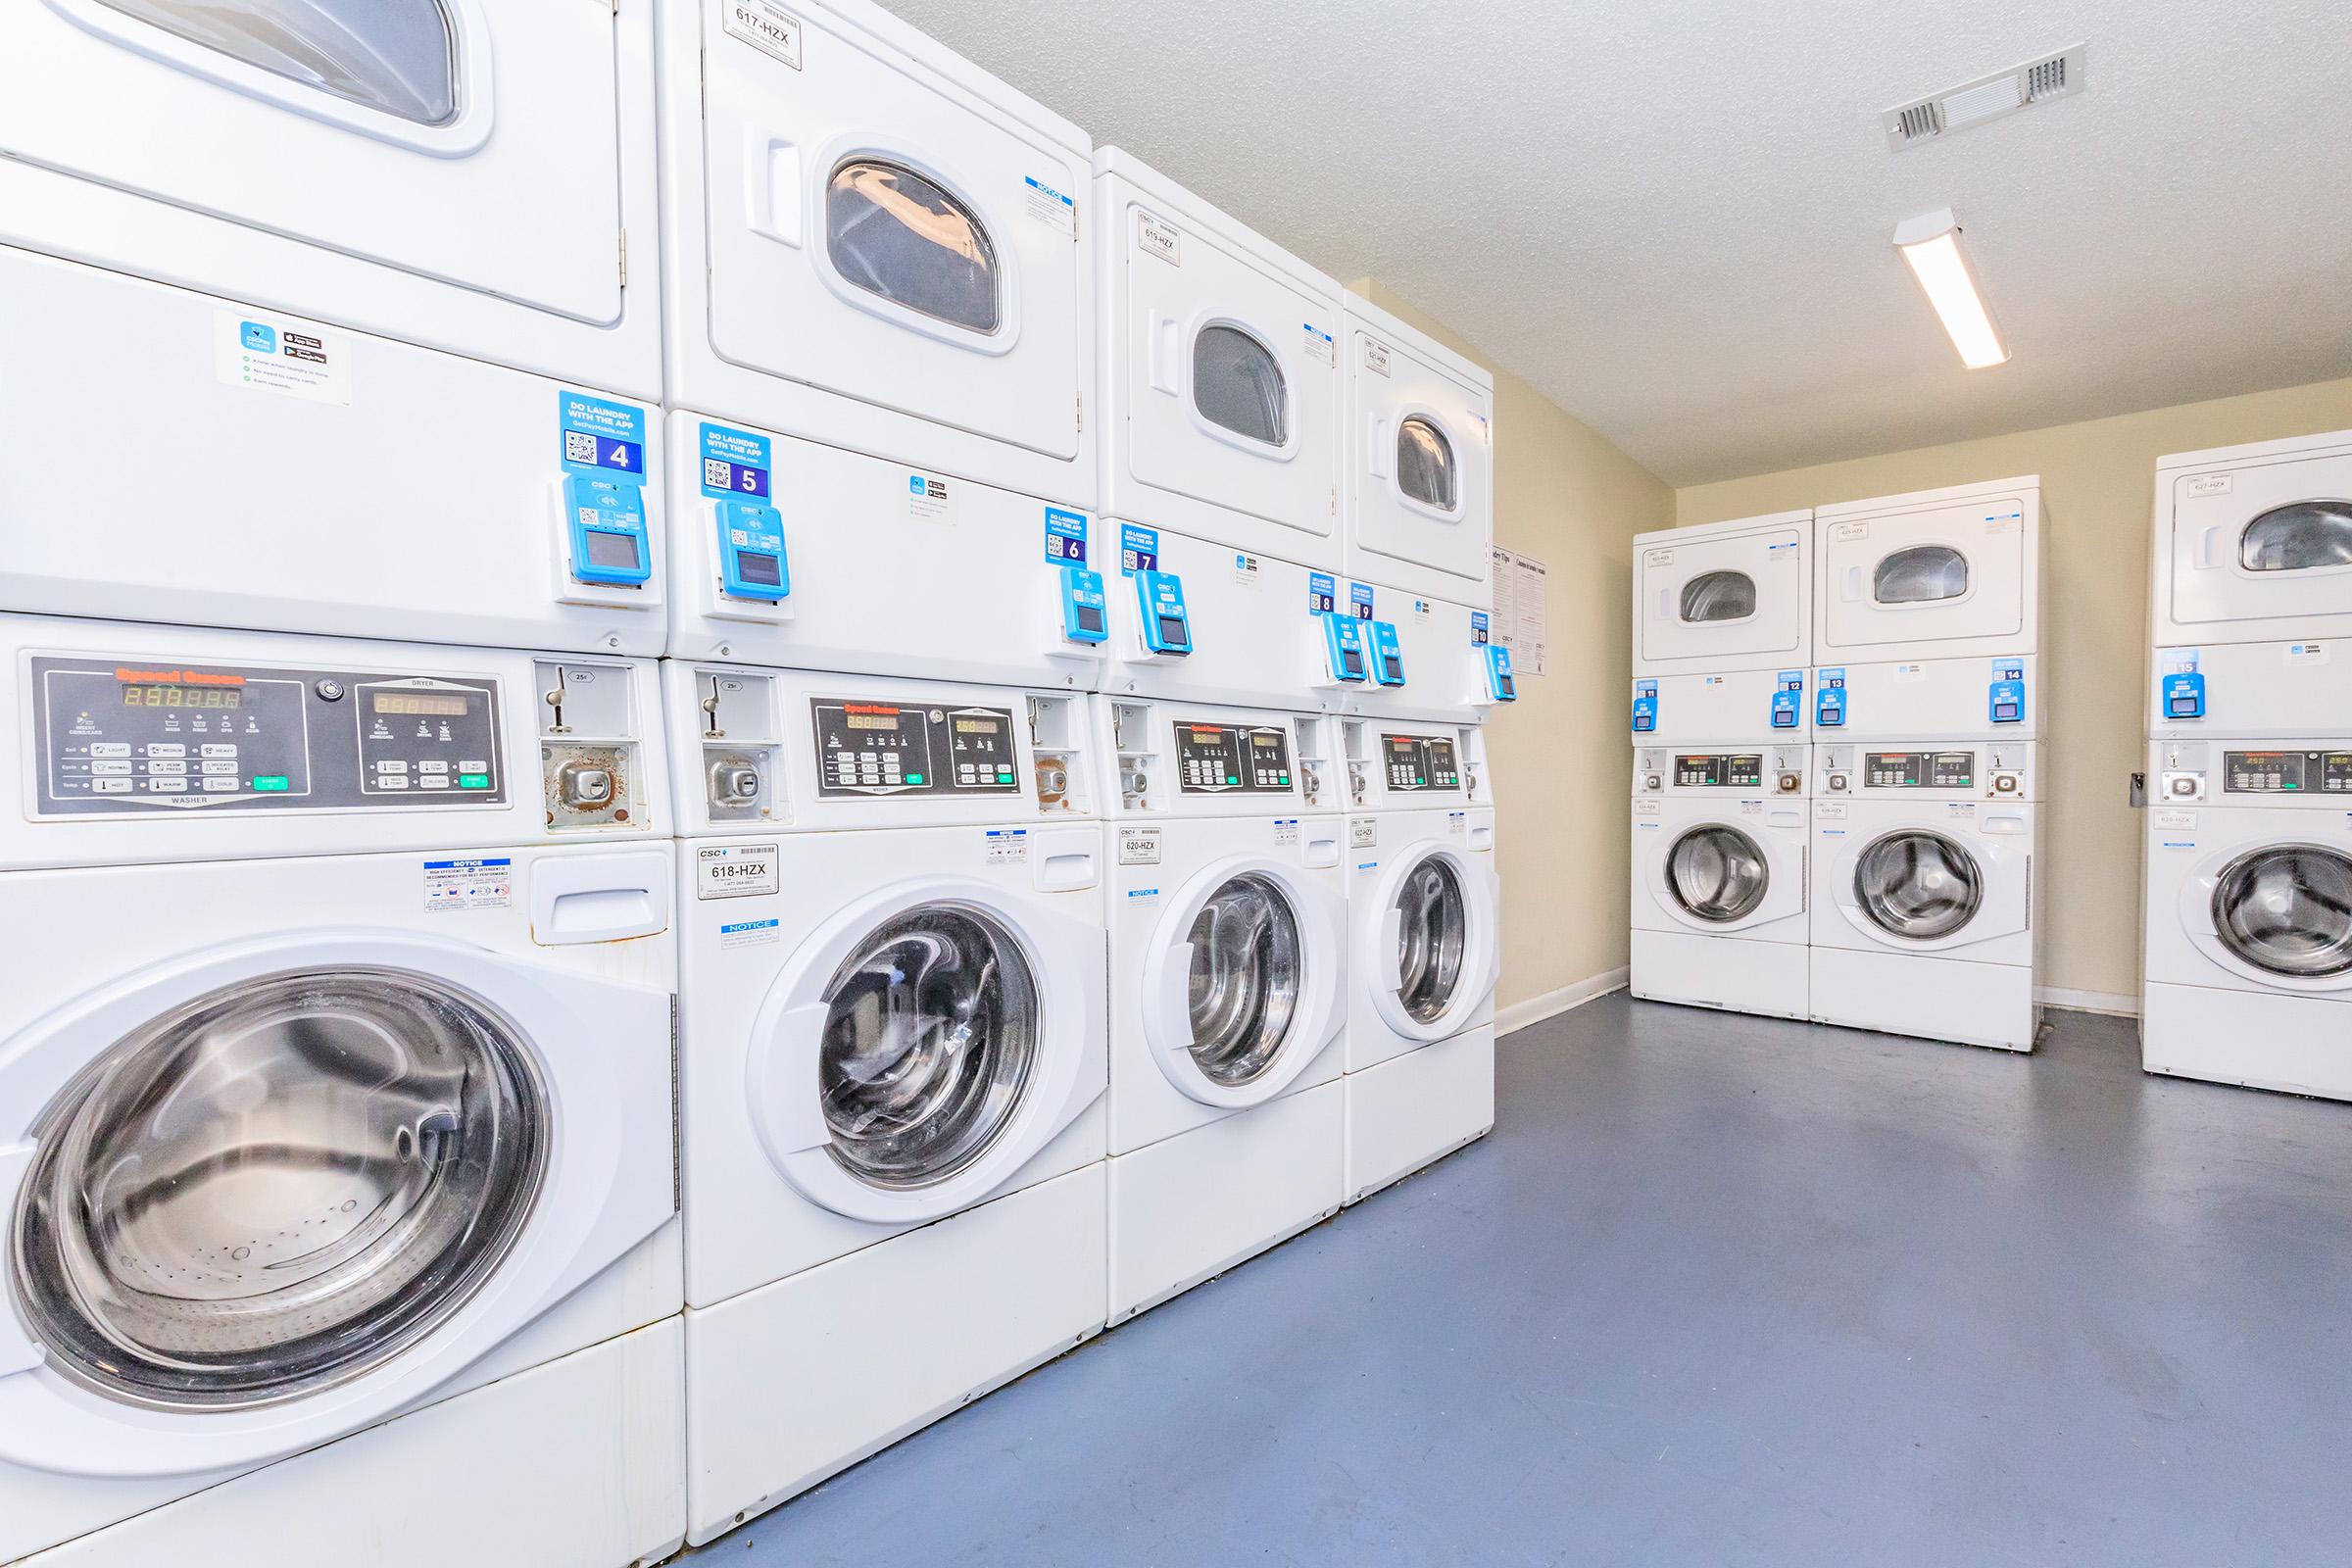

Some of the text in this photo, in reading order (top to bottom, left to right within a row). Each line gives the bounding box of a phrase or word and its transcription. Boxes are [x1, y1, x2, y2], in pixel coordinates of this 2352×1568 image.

[736, 8, 788, 45] 617-HZX
[1038, 182, 1062, 201] NOTICE
[567, 409, 634, 429] WITH THE APP
[570, 402, 631, 420] DO LAUNDRY
[572, 420, 630, 437] GetPayMobile.com
[707, 438, 761, 457] WITH THE APP
[723, 434, 760, 449] LAUNDRY
[610, 445, 628, 467] 4
[742, 469, 757, 491] 5
[1069, 541, 1079, 558] 6
[1142, 556, 1151, 570] 7
[1324, 597, 1330, 610] 8
[1363, 607, 1369, 618] 9
[1479, 630, 1487, 642] 10
[2007, 670, 2020, 679] 14
[2180, 663, 2193, 672] 15
[116, 667, 245, 685] Speed Queen
[844, 704, 901, 714] Speed Queen
[711, 863, 765, 878] 618-HZX
[729, 920, 771, 931] NOTICE
